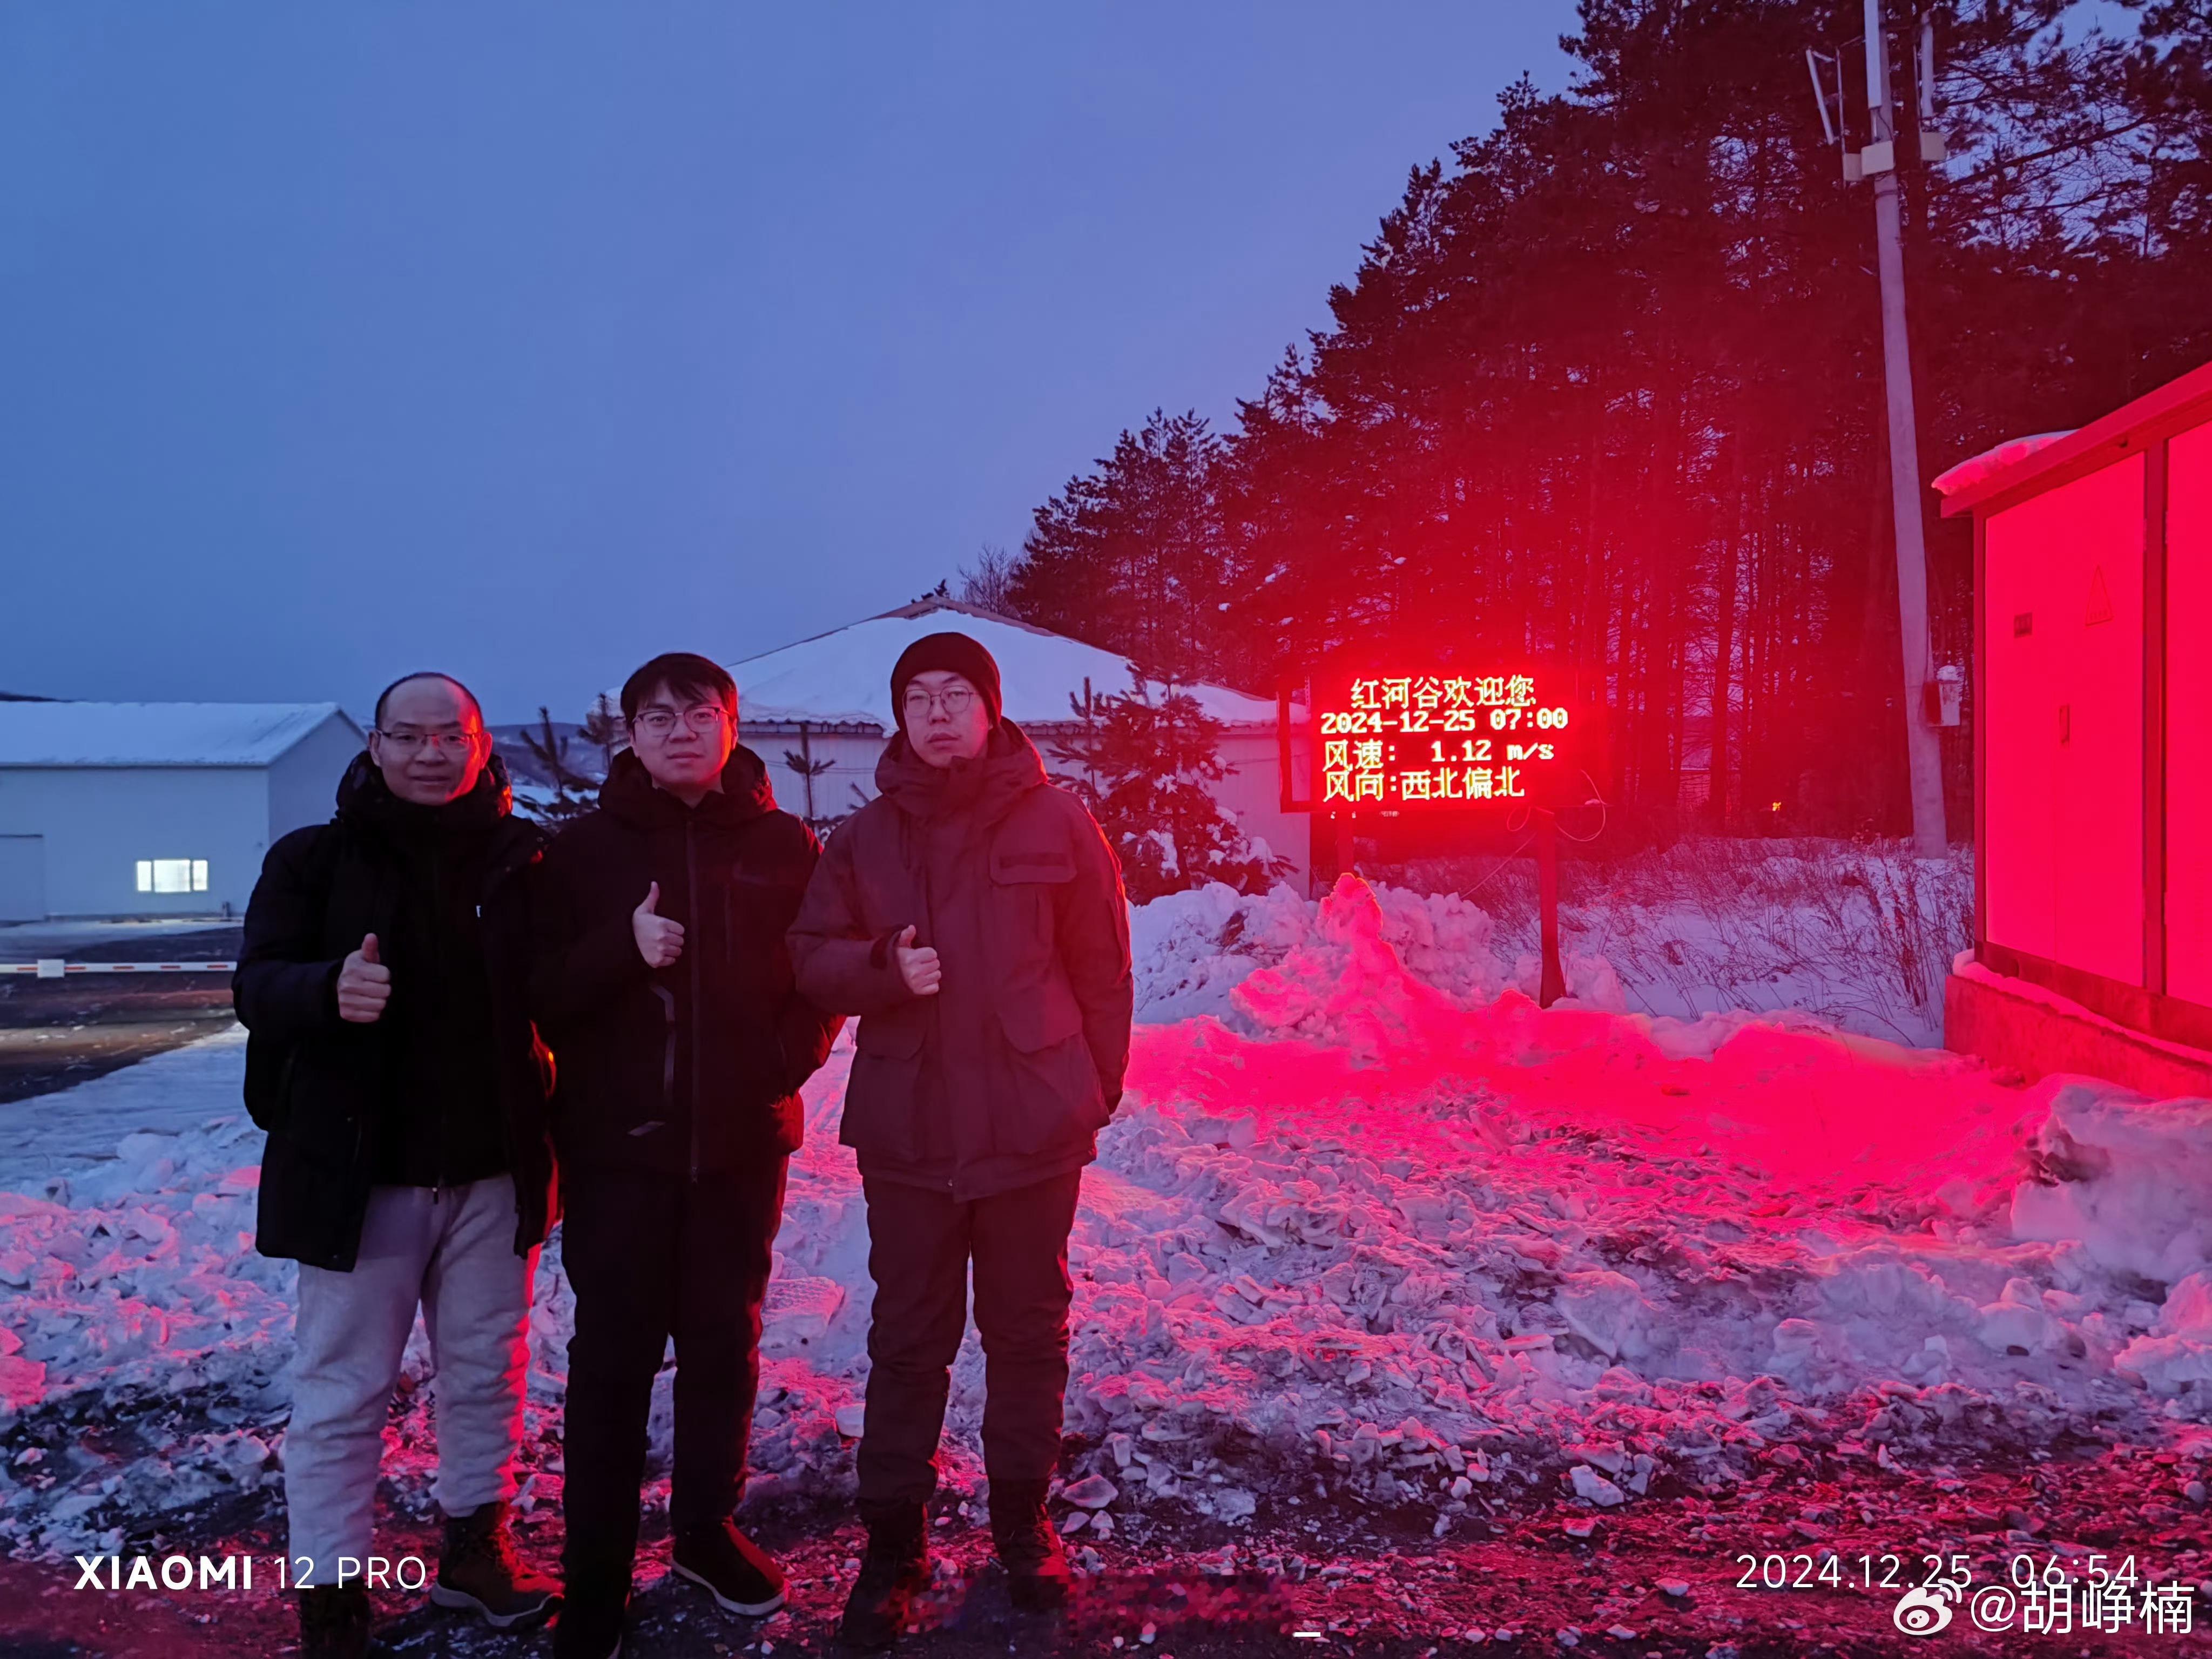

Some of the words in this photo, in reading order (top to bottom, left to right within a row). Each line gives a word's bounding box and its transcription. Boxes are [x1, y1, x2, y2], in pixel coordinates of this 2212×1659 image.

[1350, 675, 1536, 709] 红河谷欢迎您
[1321, 710, 1475, 734] 2024-12-25
[1491, 708, 1568, 730] 07:00
[1431, 740, 1492, 762] 1.12
[1507, 743, 1554, 760] m/s
